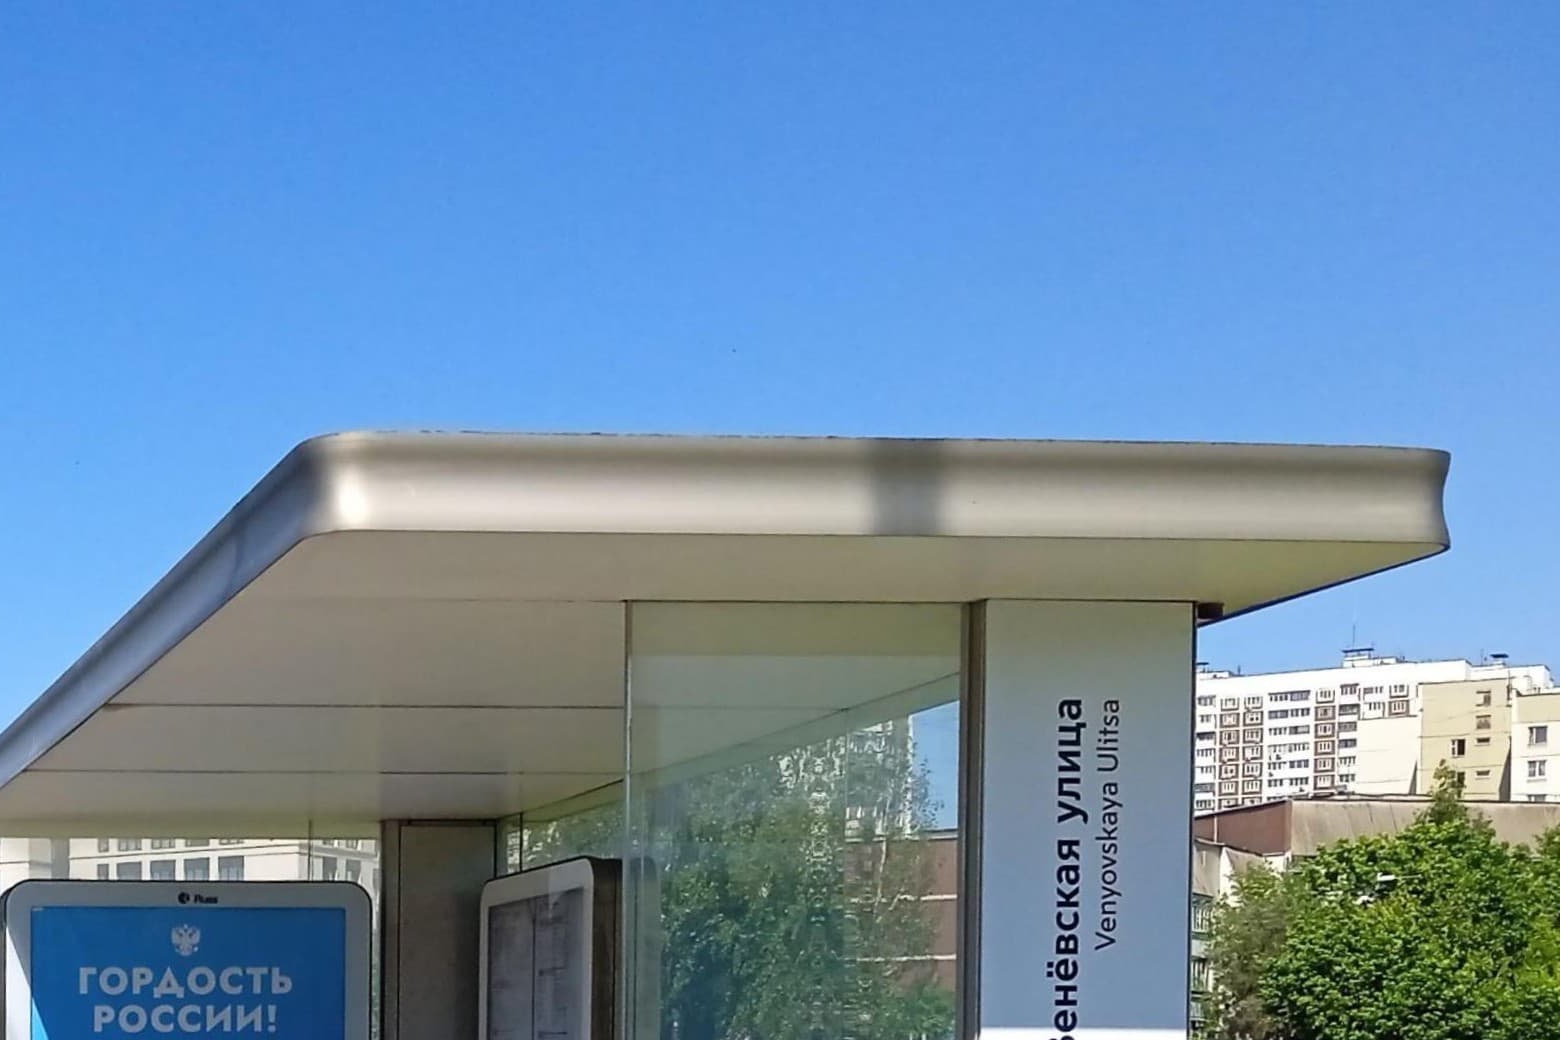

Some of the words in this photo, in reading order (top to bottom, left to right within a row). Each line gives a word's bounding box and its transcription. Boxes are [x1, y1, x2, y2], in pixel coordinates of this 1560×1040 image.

[1056, 697, 1089, 825] улица
[1096, 698, 1121, 772] Ulitsa
[1094, 781, 1124, 952] Venyovskaya
[78, 966, 294, 999] ГОРДОСТЬ
[93, 1003, 278, 1034] РОССИИ!
